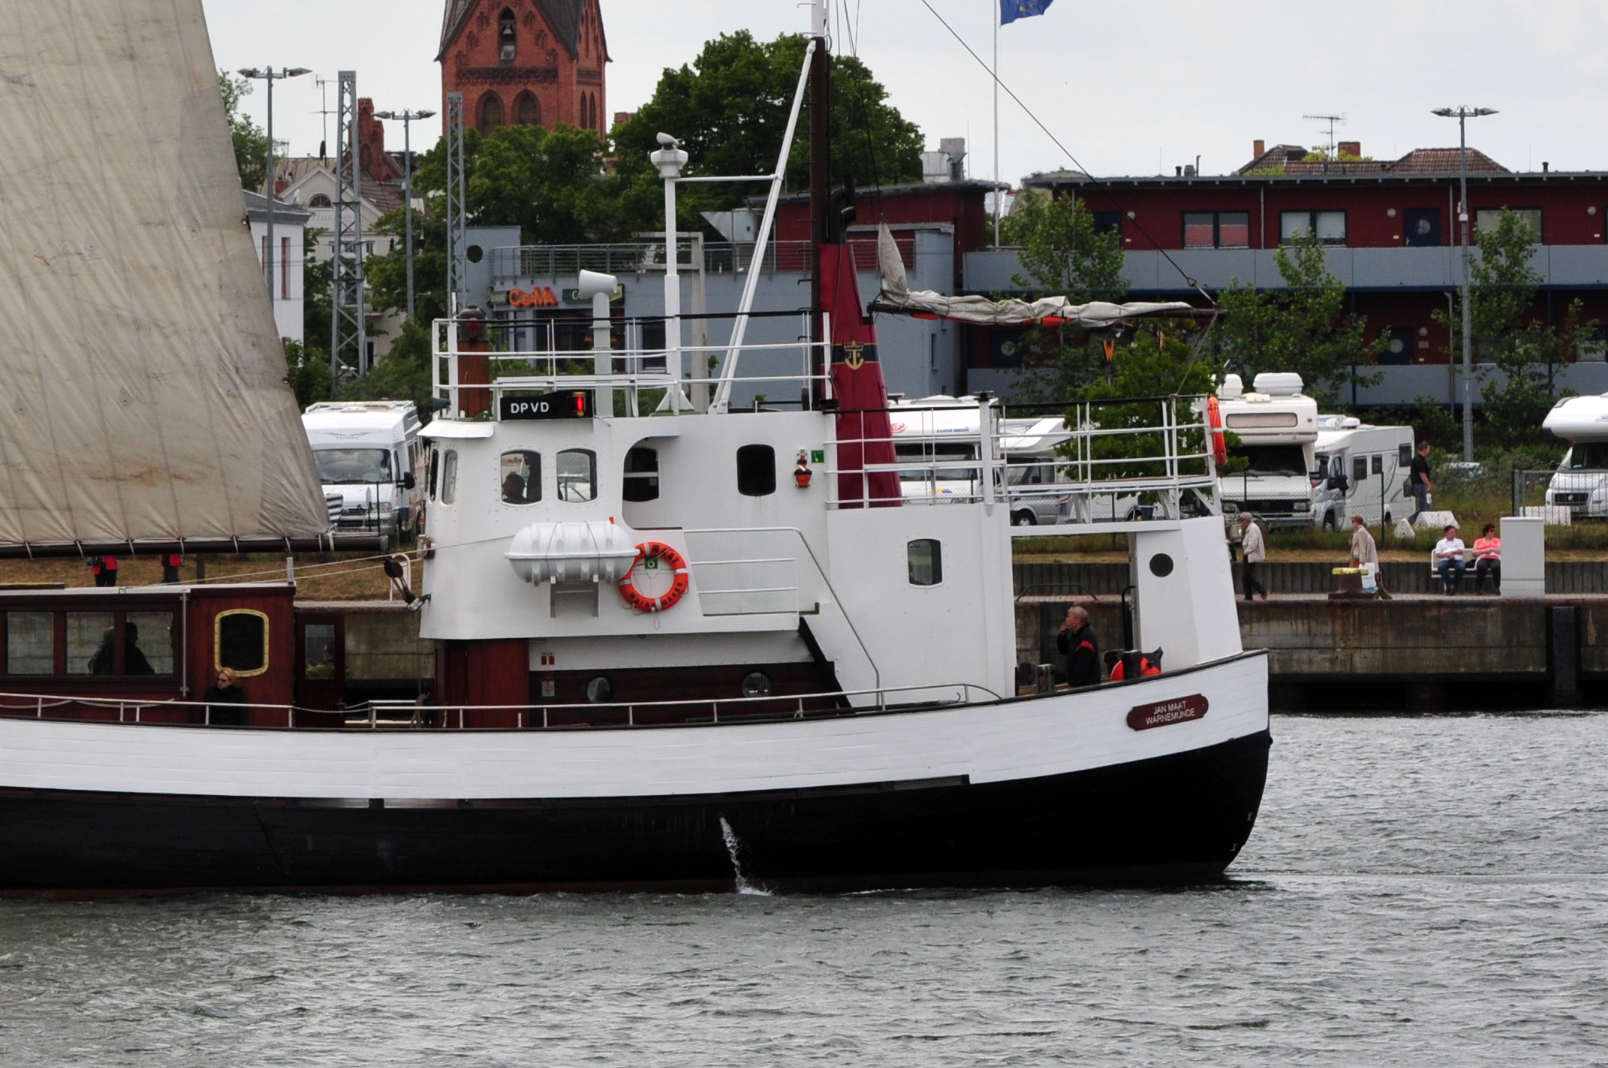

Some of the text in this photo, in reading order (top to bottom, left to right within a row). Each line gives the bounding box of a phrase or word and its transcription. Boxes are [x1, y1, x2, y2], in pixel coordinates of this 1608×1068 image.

[510, 401, 550, 414] DPVD
[1153, 700, 1187, 715] JAN MAAT
